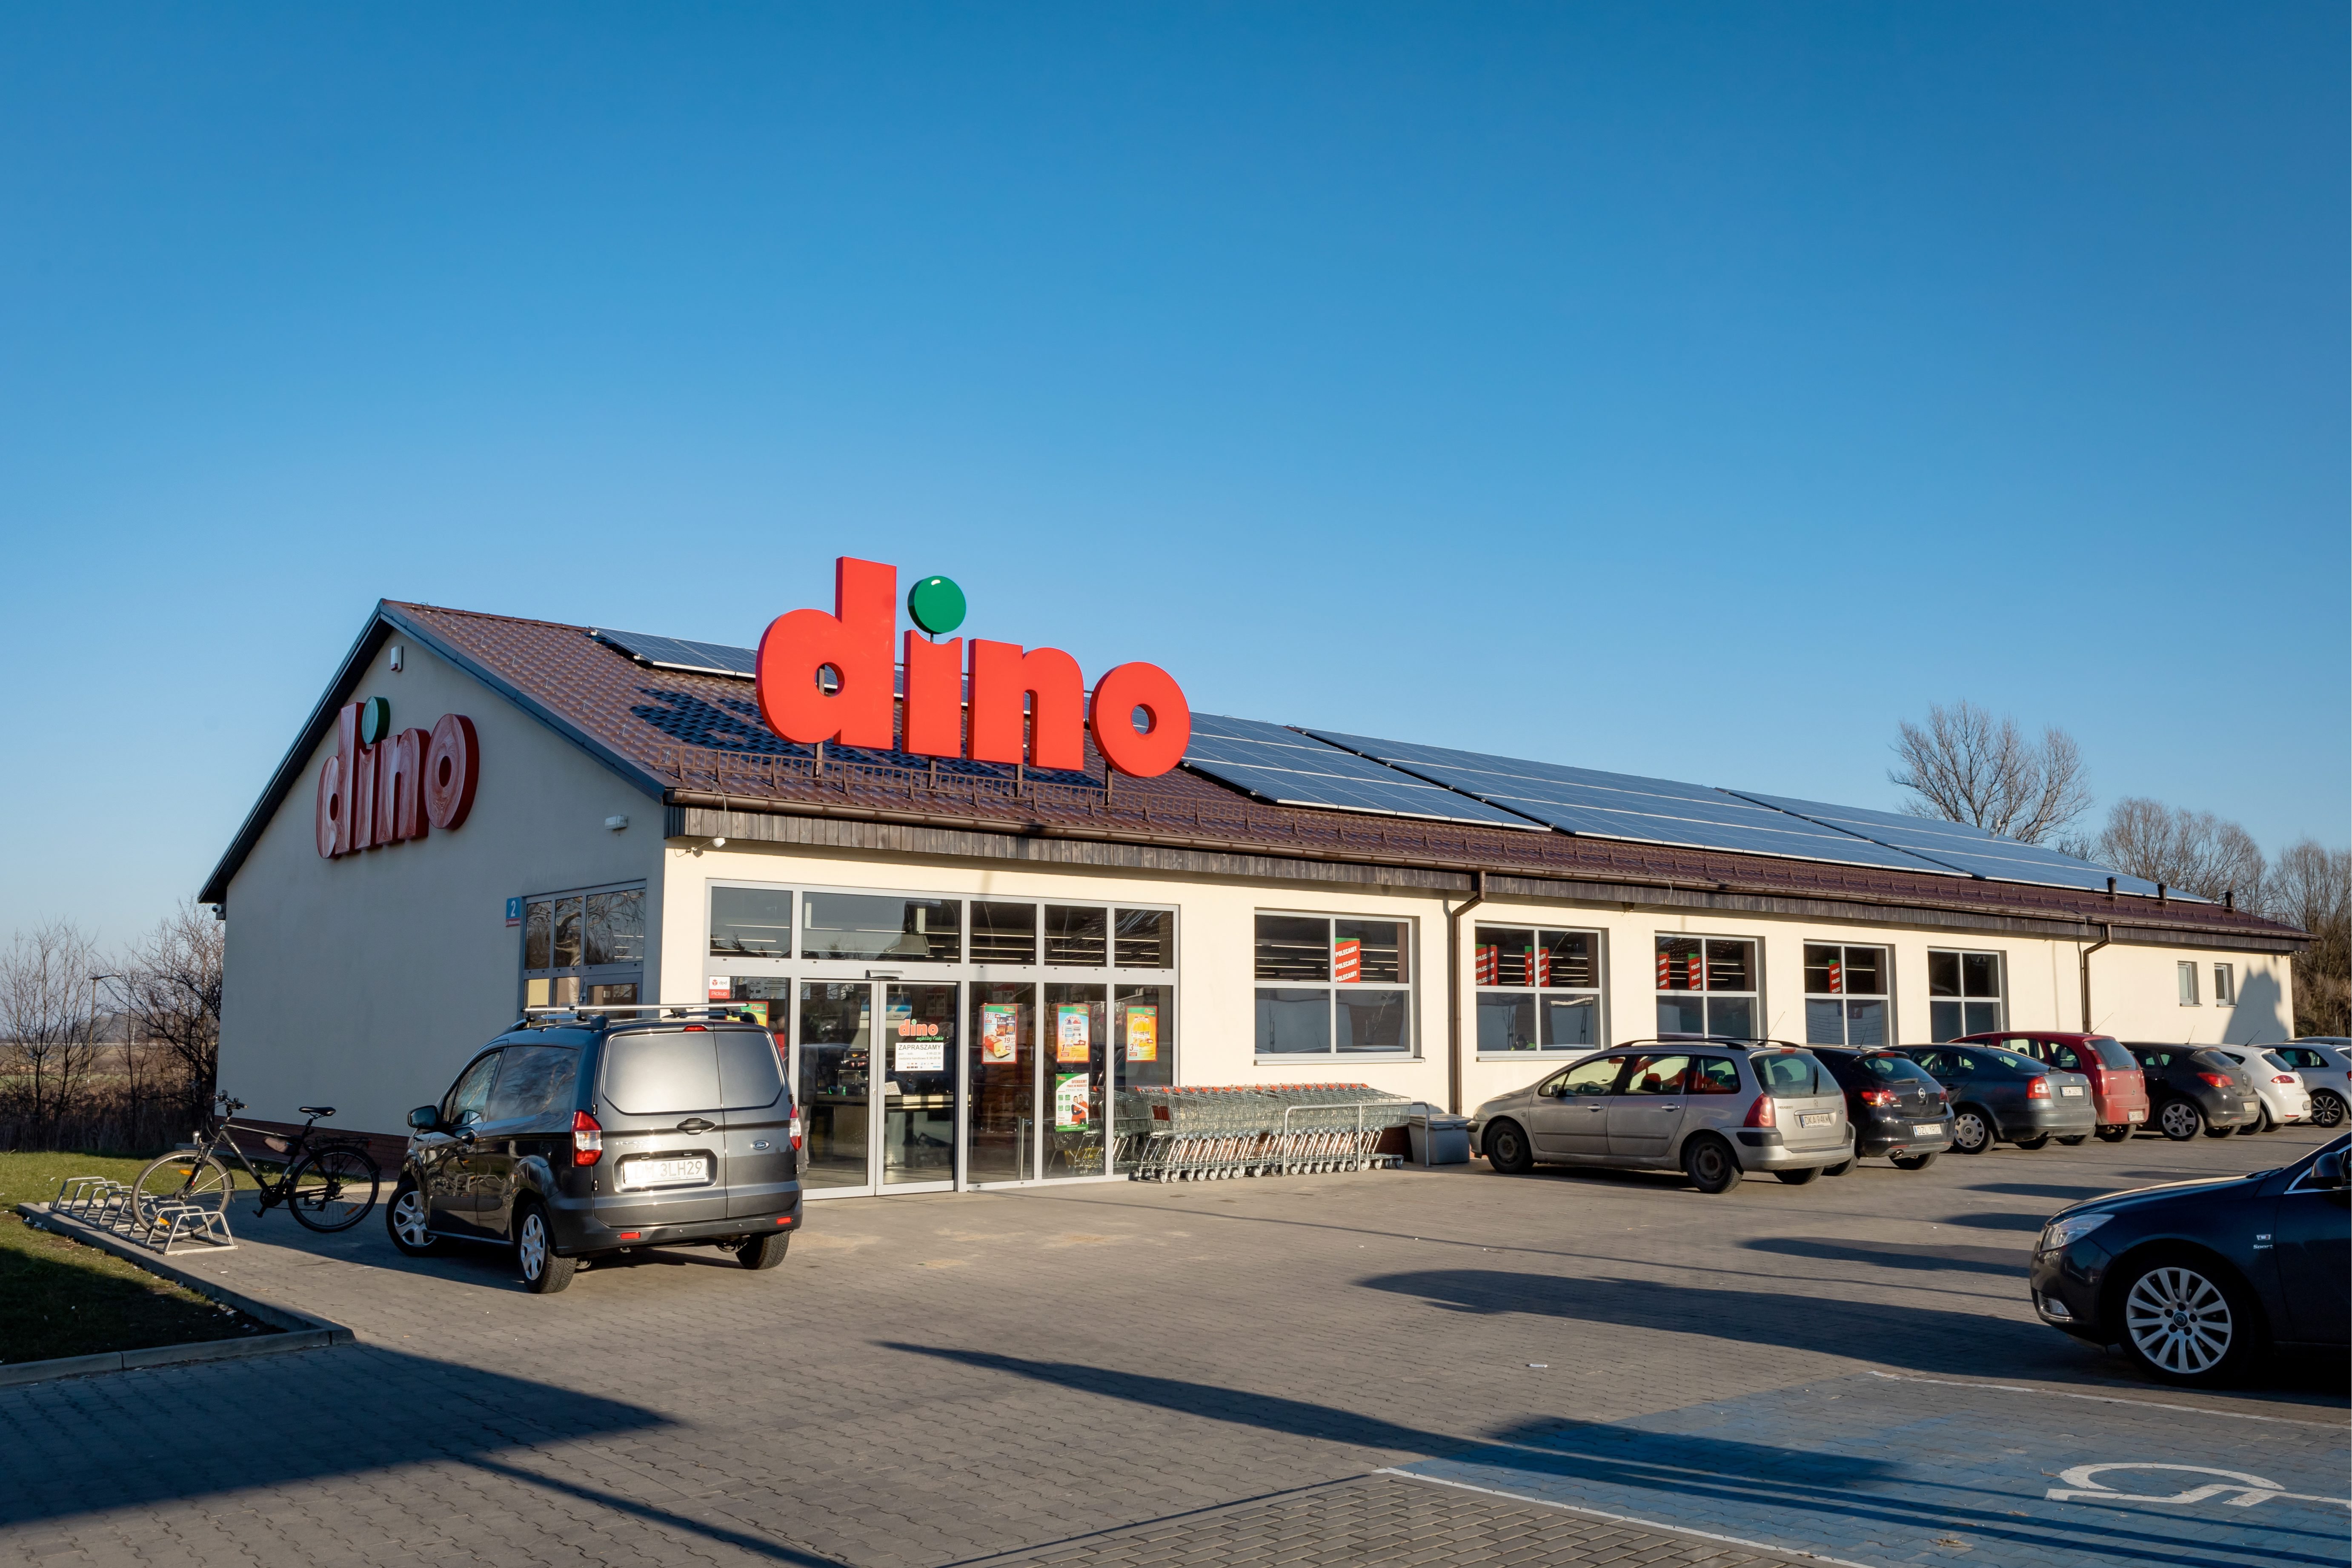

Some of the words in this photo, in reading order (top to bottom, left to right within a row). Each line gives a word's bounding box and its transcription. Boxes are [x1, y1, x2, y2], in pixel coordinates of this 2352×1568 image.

[756, 556, 1190, 777] dino
[316, 696, 480, 859] dino
[511, 900, 516, 917] 2
[1335, 945, 1357, 957] POLECAMY
[1335, 958, 1357, 970] POLECAMY
[1335, 970, 1357, 982] POLECAMY
[898, 1019, 939, 1036] dino
[1804, 1116, 1816, 1125] DKA
[1917, 1126, 1929, 1134] DZL
[660, 1161, 702, 1177] 3LH29
